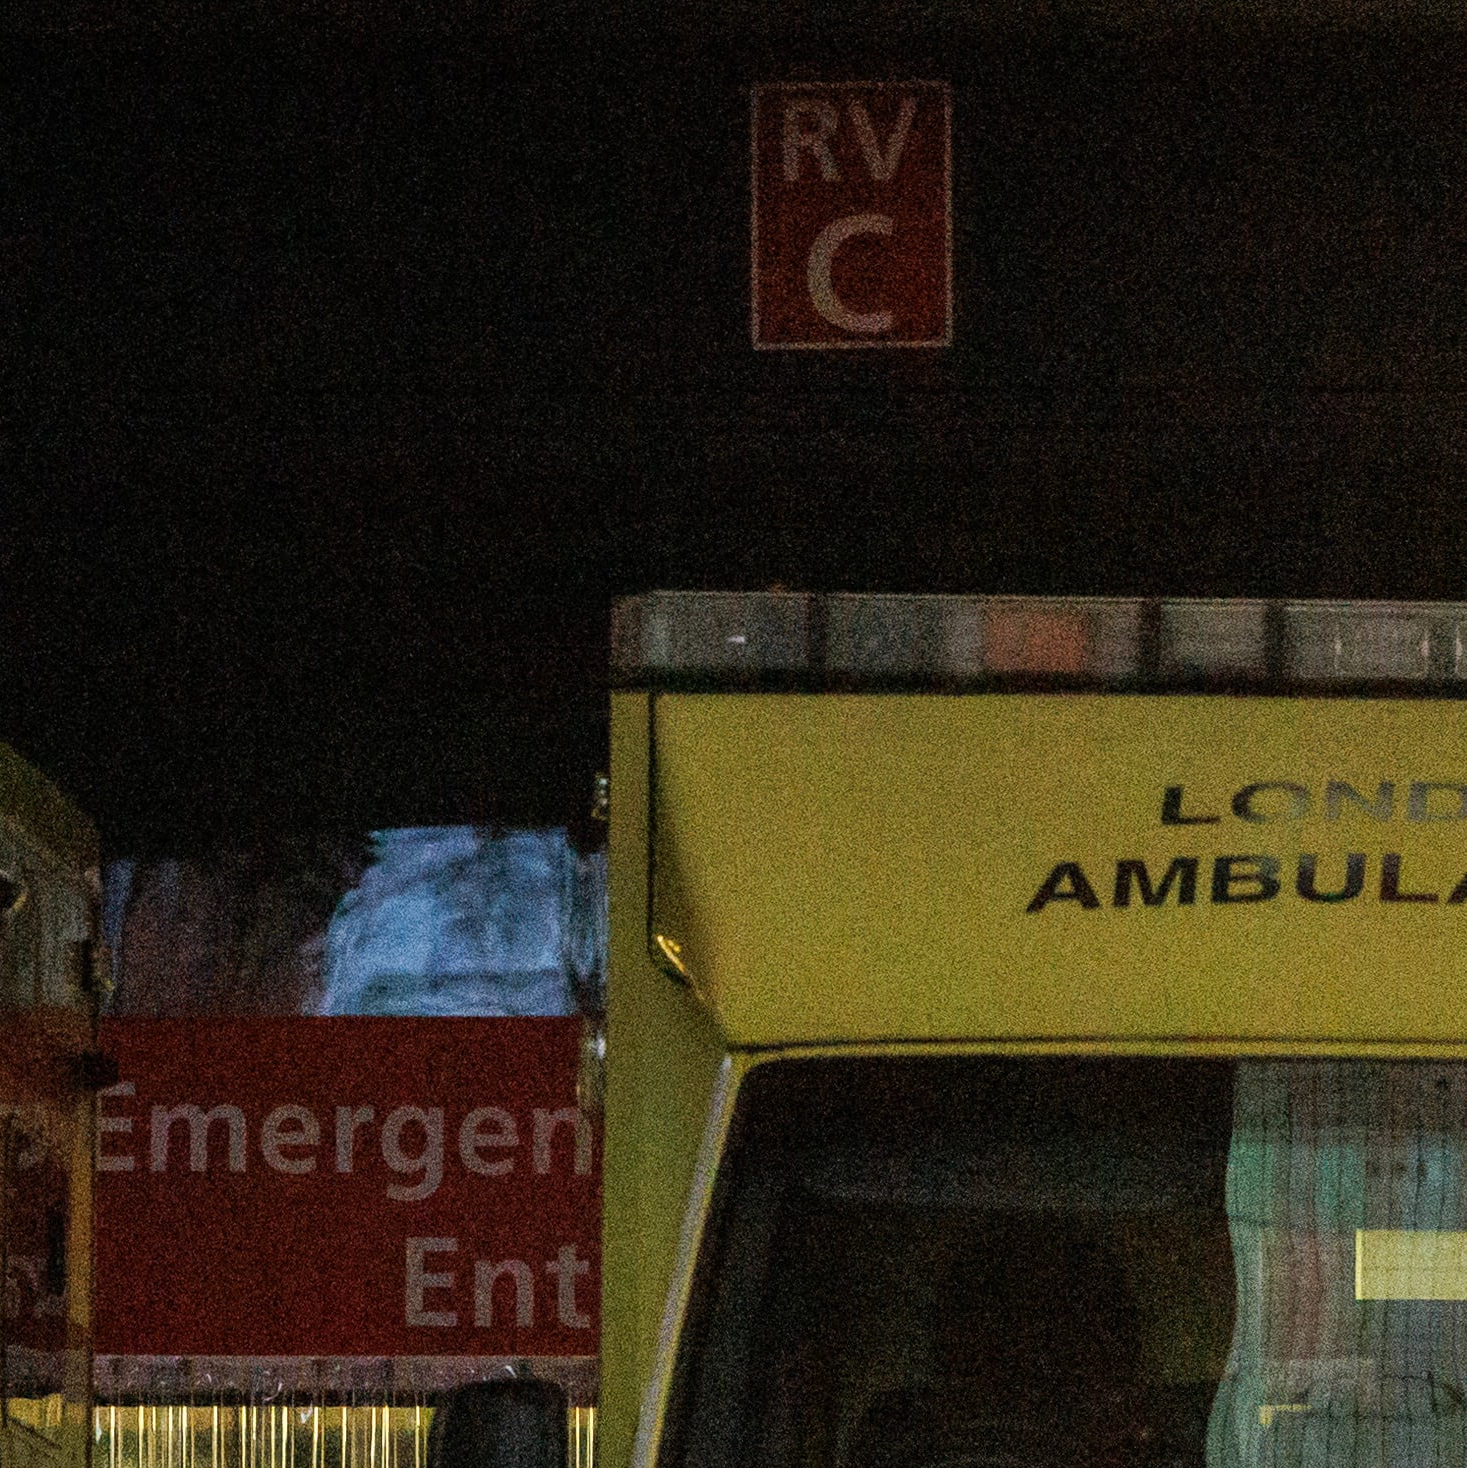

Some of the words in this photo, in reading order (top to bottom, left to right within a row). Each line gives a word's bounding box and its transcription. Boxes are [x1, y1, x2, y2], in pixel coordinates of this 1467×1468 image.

[781, 97, 920, 182] RV
[806, 213, 895, 333] C
[1026, 852, 1467, 914] AMBUL
